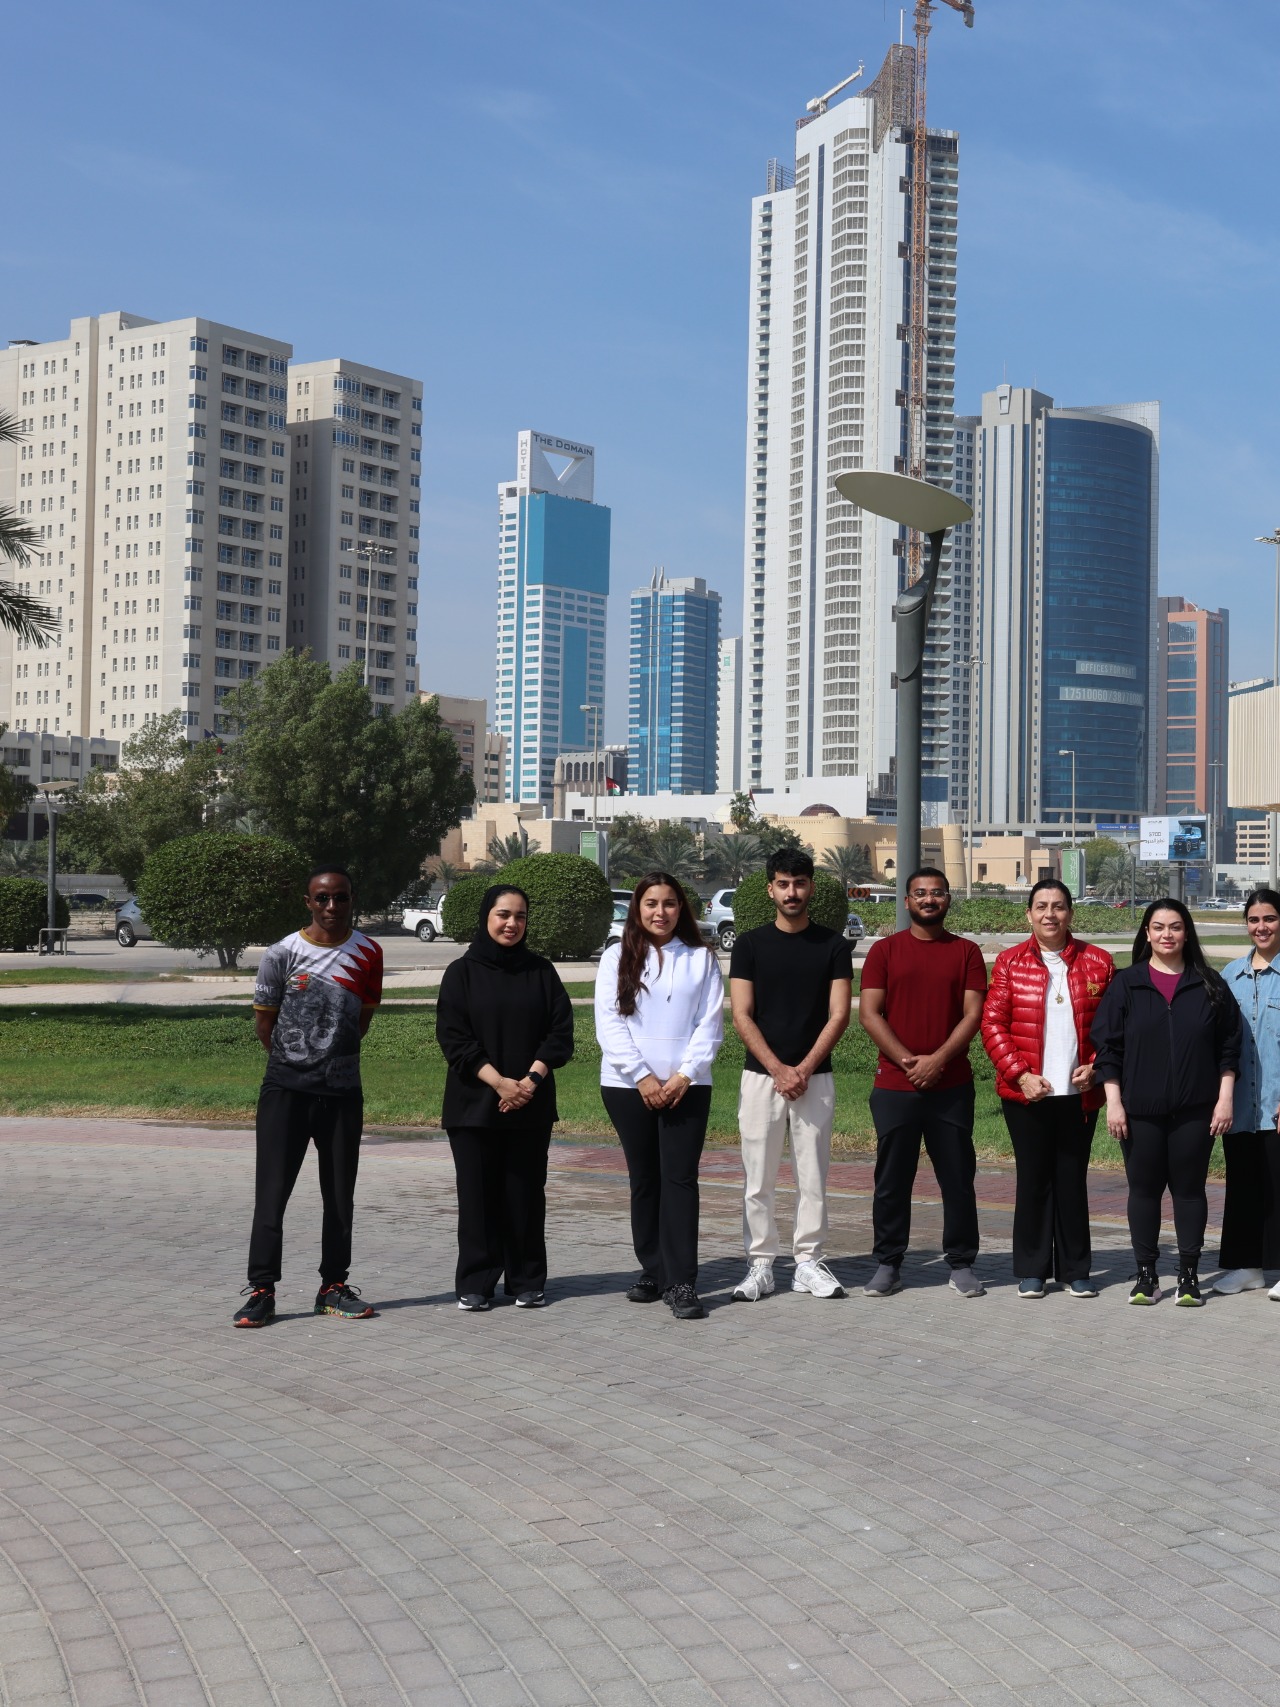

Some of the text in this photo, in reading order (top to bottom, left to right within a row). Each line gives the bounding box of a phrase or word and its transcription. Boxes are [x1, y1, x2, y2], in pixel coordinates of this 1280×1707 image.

[533, 434, 592, 456] THE DOMAIN
[1080, 663, 1108, 674] OFFICES
